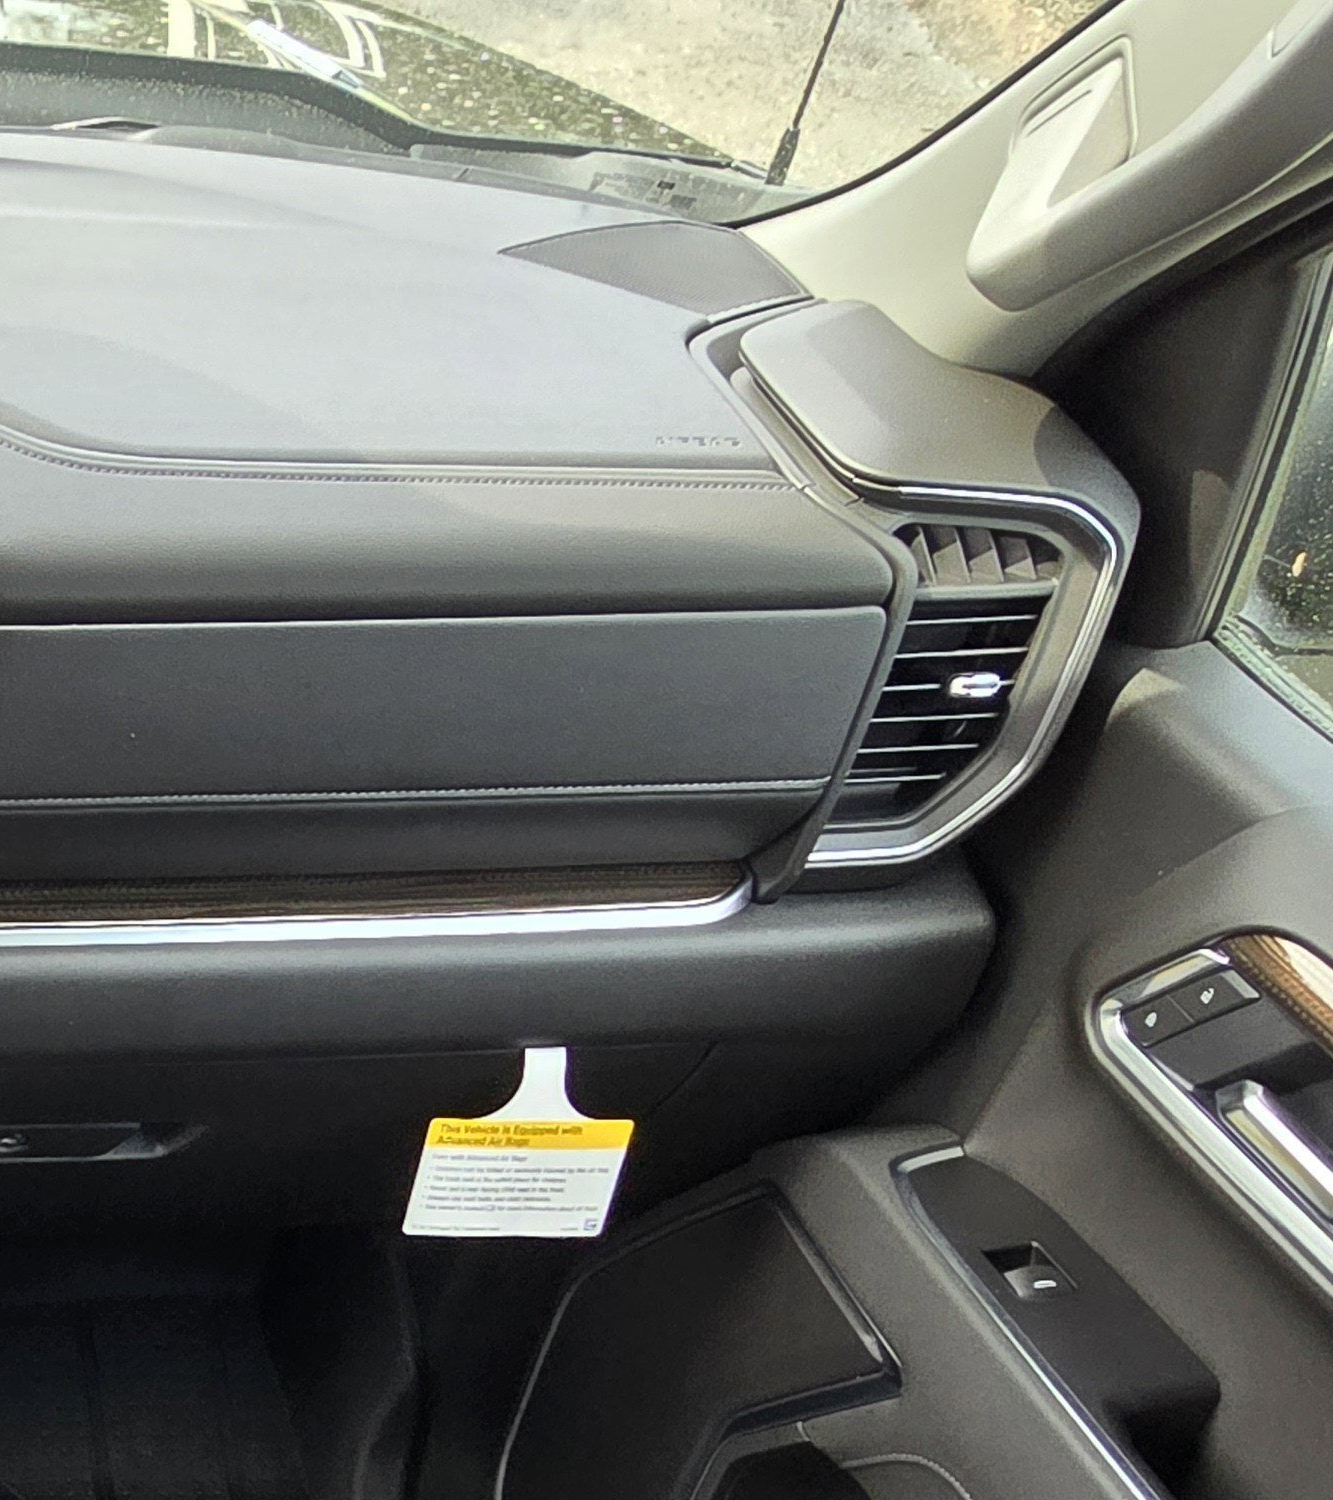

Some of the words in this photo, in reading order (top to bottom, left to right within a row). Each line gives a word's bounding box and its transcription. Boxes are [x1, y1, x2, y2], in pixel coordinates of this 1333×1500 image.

[441, 1124, 461, 1134] This
[464, 1125, 500, 1135] Vehicle
[513, 1125, 560, 1137] Equipped
[561, 1126, 583, 1136] with
[436, 1135, 487, 1146] Advanced
[487, 1137, 503, 1146] Air
[504, 1137, 530, 1148] Bags
